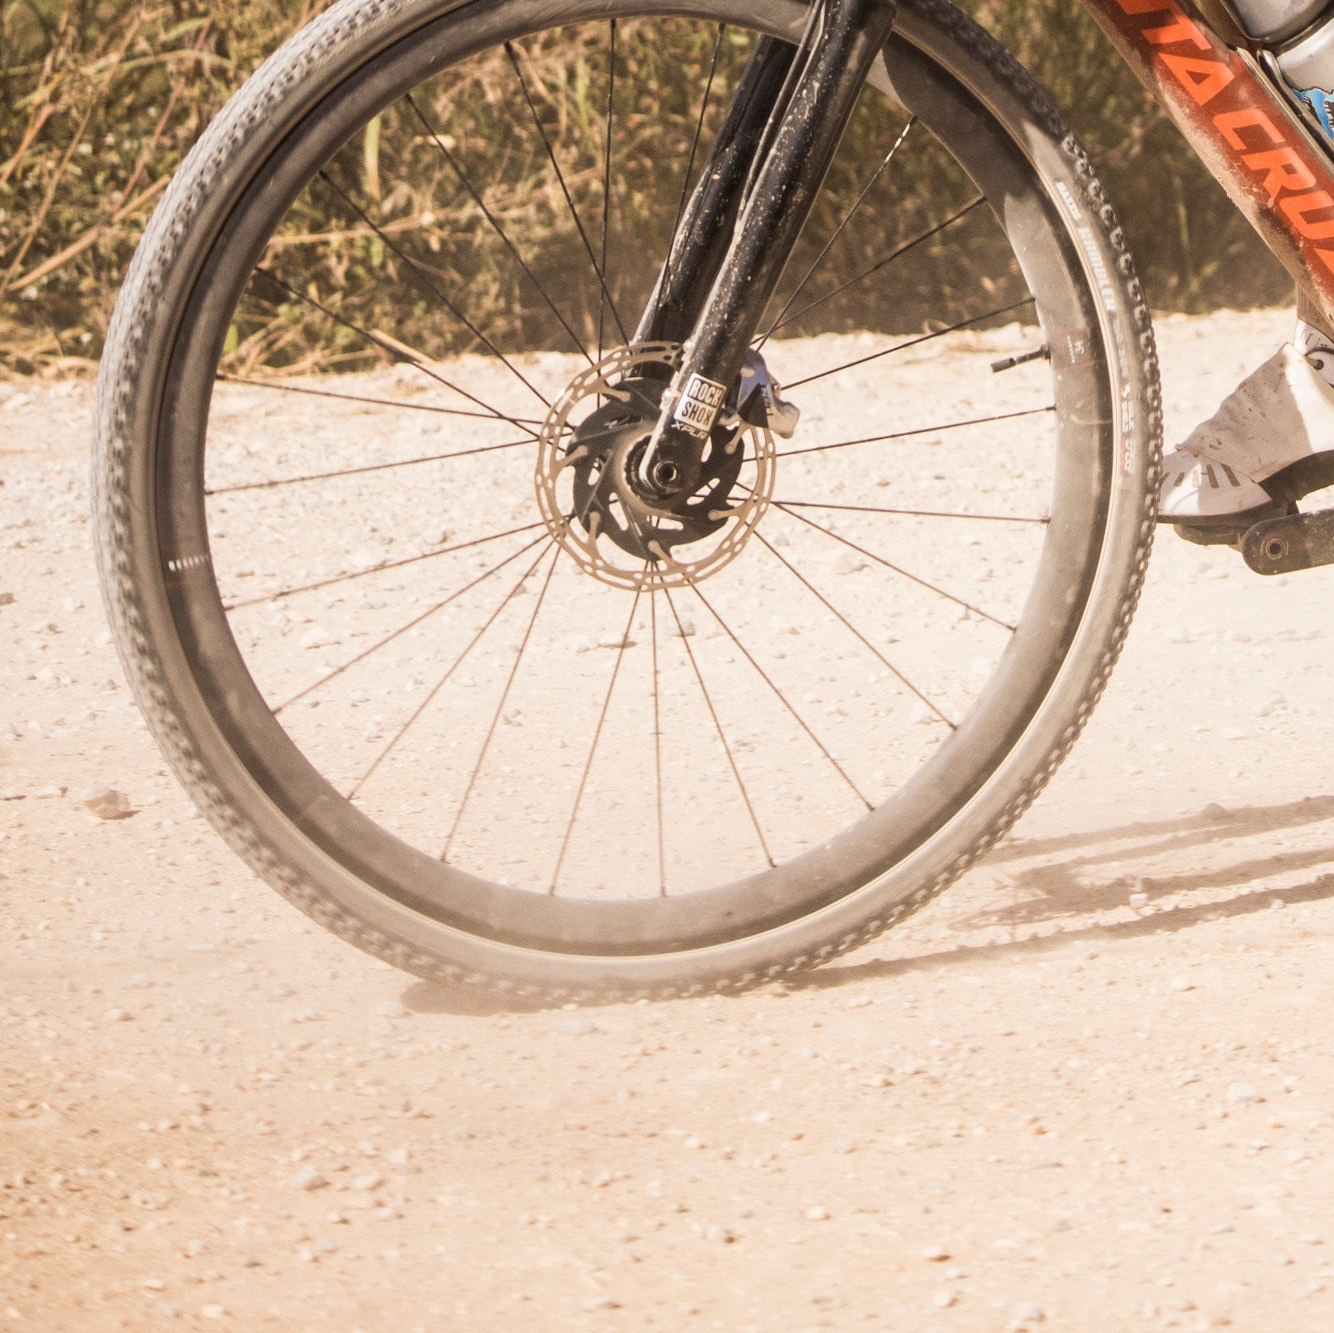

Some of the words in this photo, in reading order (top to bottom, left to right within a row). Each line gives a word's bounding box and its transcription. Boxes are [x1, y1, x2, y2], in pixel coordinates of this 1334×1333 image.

[688, 379, 723, 408] ROCK
[681, 401, 714, 427] SHOX
[671, 420, 708, 440] XPLR
